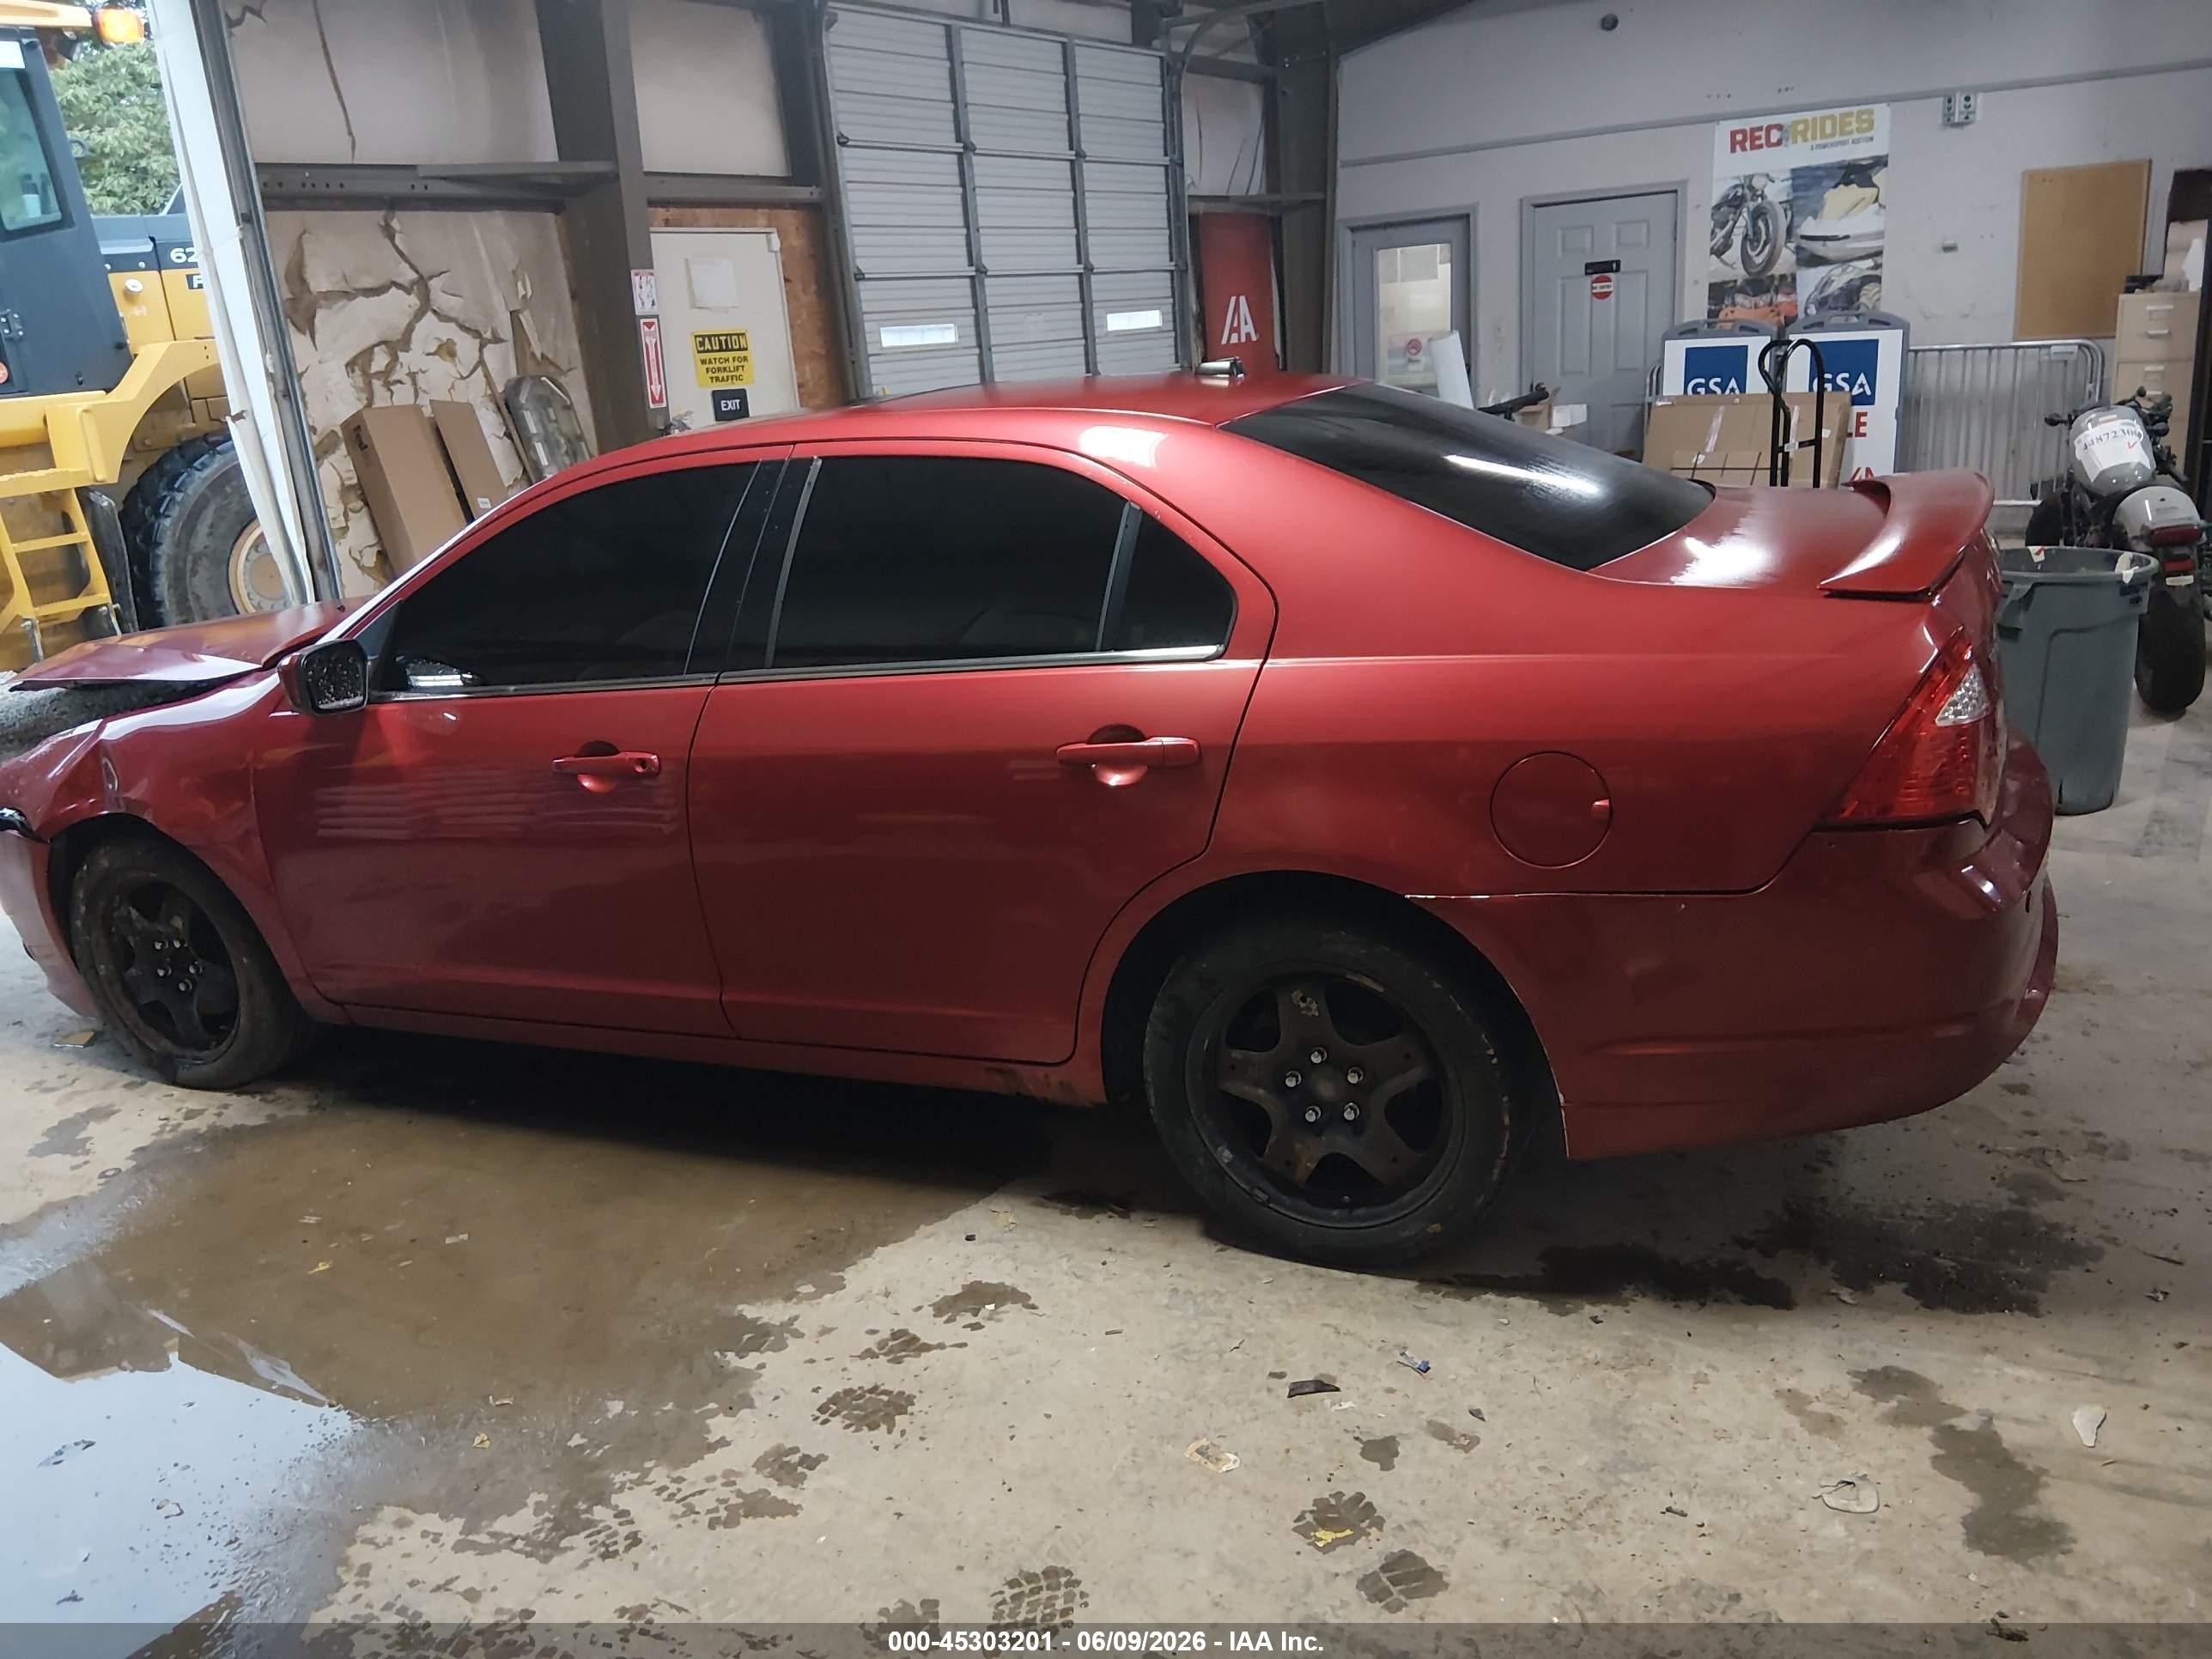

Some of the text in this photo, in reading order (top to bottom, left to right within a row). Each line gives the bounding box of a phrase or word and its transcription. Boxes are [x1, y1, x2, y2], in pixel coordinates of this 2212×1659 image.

[1729, 123, 1784, 154] REC
[1790, 108, 1875, 144] RIDES
[696, 335, 748, 351] CAUTION
[700, 357, 730, 366] WATCH
[705, 365, 745, 374] FORKLIFT
[709, 374, 744, 383] TRAFFIC
[1813, 371, 1871, 396] GSA
[1687, 377, 1741, 395] GSA
[721, 399, 740, 411] EXIT
